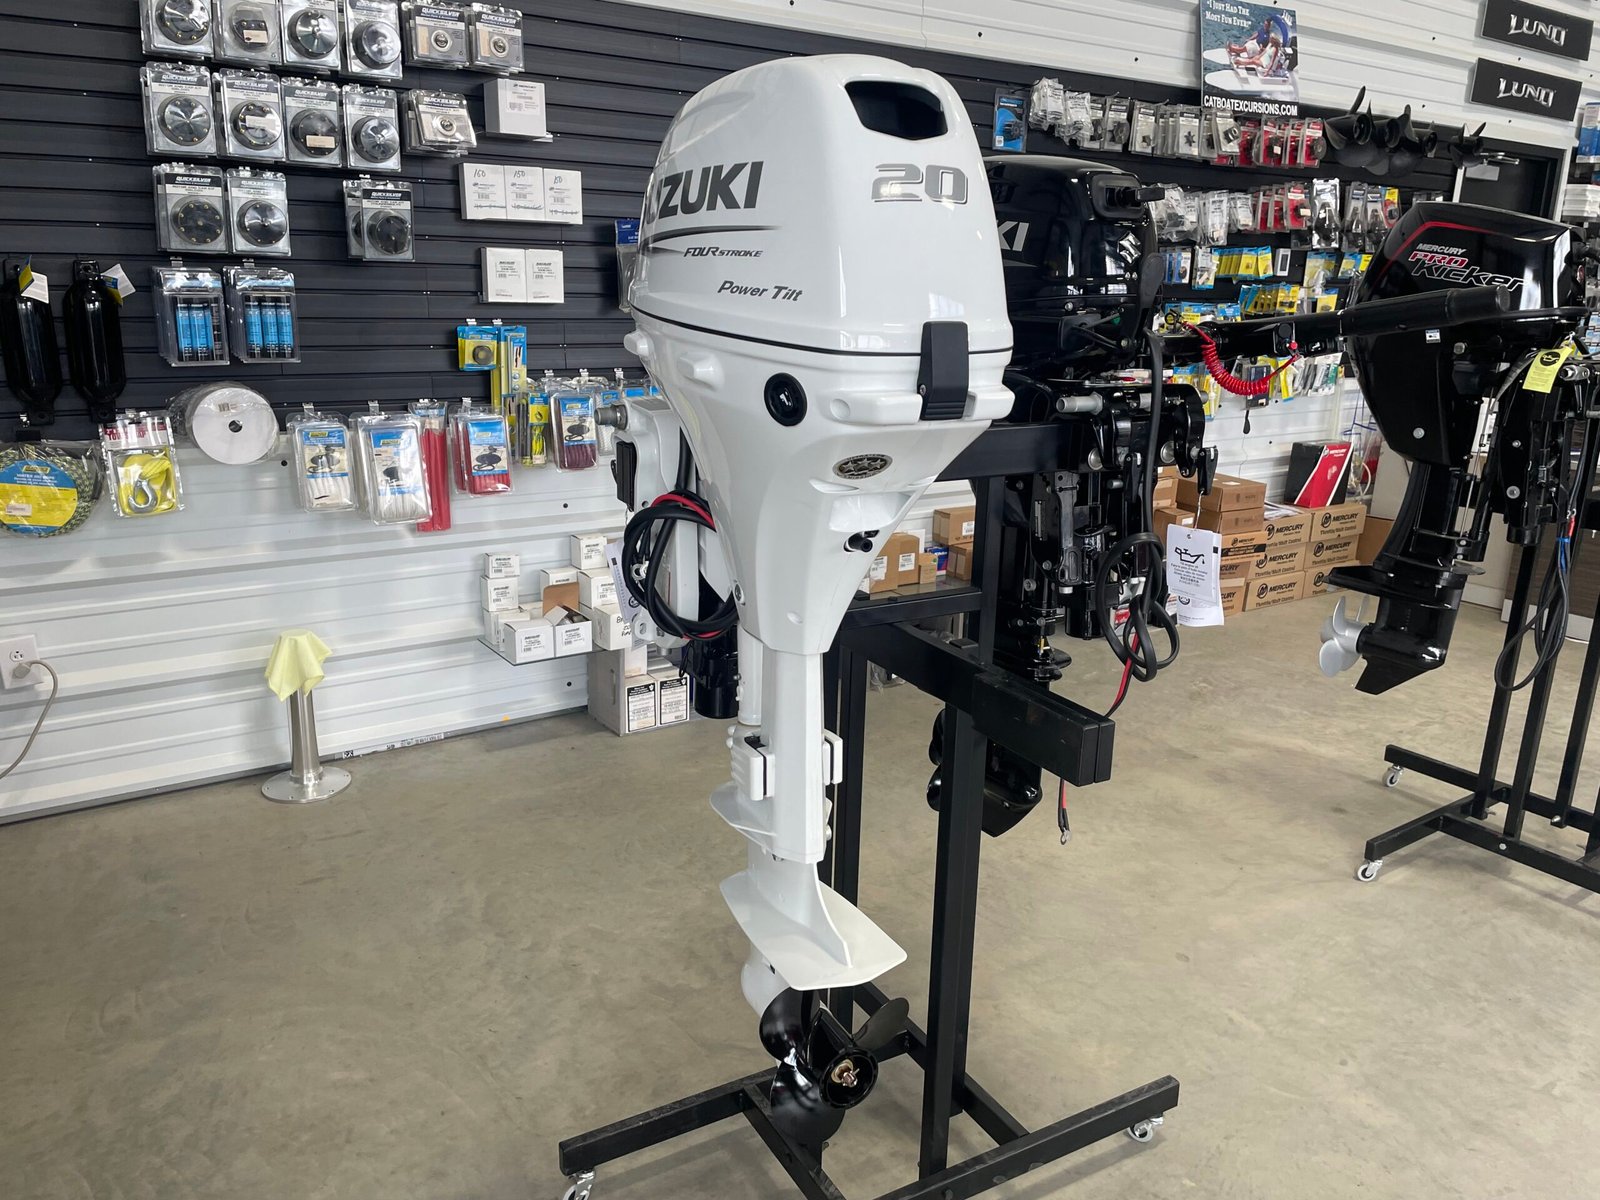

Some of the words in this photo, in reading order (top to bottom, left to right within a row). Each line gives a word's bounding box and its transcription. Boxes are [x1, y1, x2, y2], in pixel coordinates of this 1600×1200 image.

[422, 7, 460, 17] QUICKSILVER
[1226, 3, 1238, 13] HAD
[1238, 6, 1250, 16] THE
[481, 14, 517, 24] QUICKSILVER
[1205, 11, 1221, 20] MOST
[1221, 14, 1232, 24] FUN
[1508, 13, 1567, 47] LUND
[1497, 78, 1555, 108] LUND
[424, 97, 460, 105] QUICKSILVER
[1204, 95, 1298, 116] CATBOATEXCURSIONS.COM
[871, 163, 969, 205] 20
[642, 161, 764, 225] UZUKI
[1416, 243, 1467, 256] MERCURY
[1408, 250, 1469, 268] PRO
[717, 280, 768, 297] Power
[771, 285, 803, 301] Tilt
[1332, 512, 1359, 522] MERCURY
[1275, 523, 1304, 533] MERCURY
[1325, 541, 1352, 551] MERCURY
[1268, 552, 1298, 561] MERCURY
[1220, 564, 1240, 572] CURY
[1269, 581, 1297, 592] MERCURY
[1221, 591, 1237, 600] CURY
